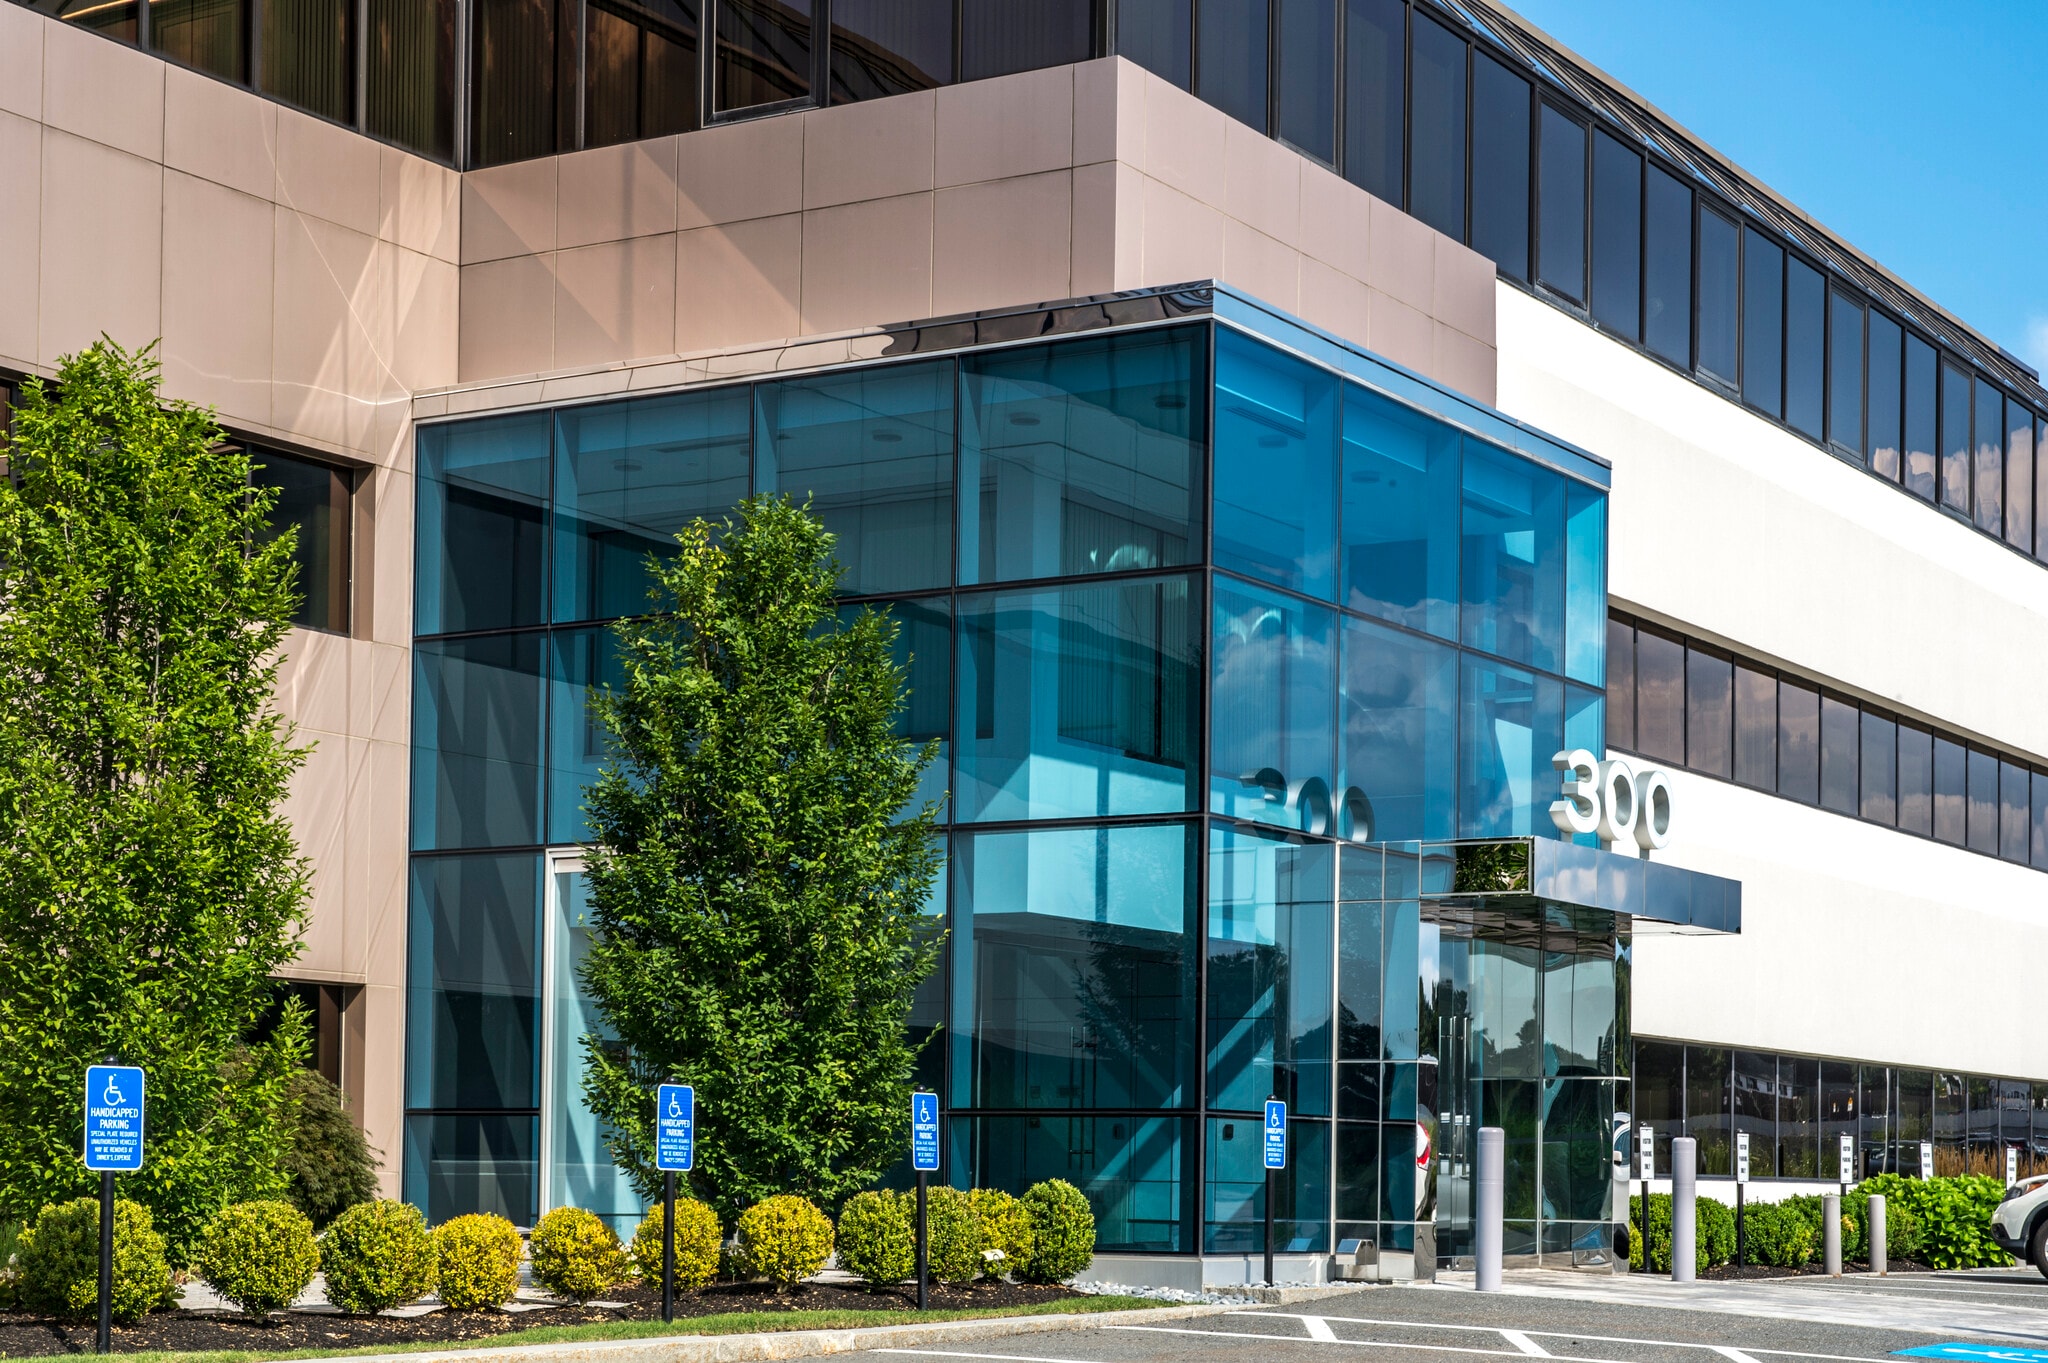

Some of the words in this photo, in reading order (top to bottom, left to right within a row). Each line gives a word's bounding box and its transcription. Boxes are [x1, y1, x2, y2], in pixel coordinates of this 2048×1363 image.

[1549, 748, 1674, 850] 300
[90, 1106, 139, 1118] HANDICAPPED
[99, 1119, 130, 1130] PARKING
[660, 1118, 691, 1128] HANDICAPPED
[119, 1130, 138, 1138] REQUIRED
[666, 1128, 685, 1137] PARKING
